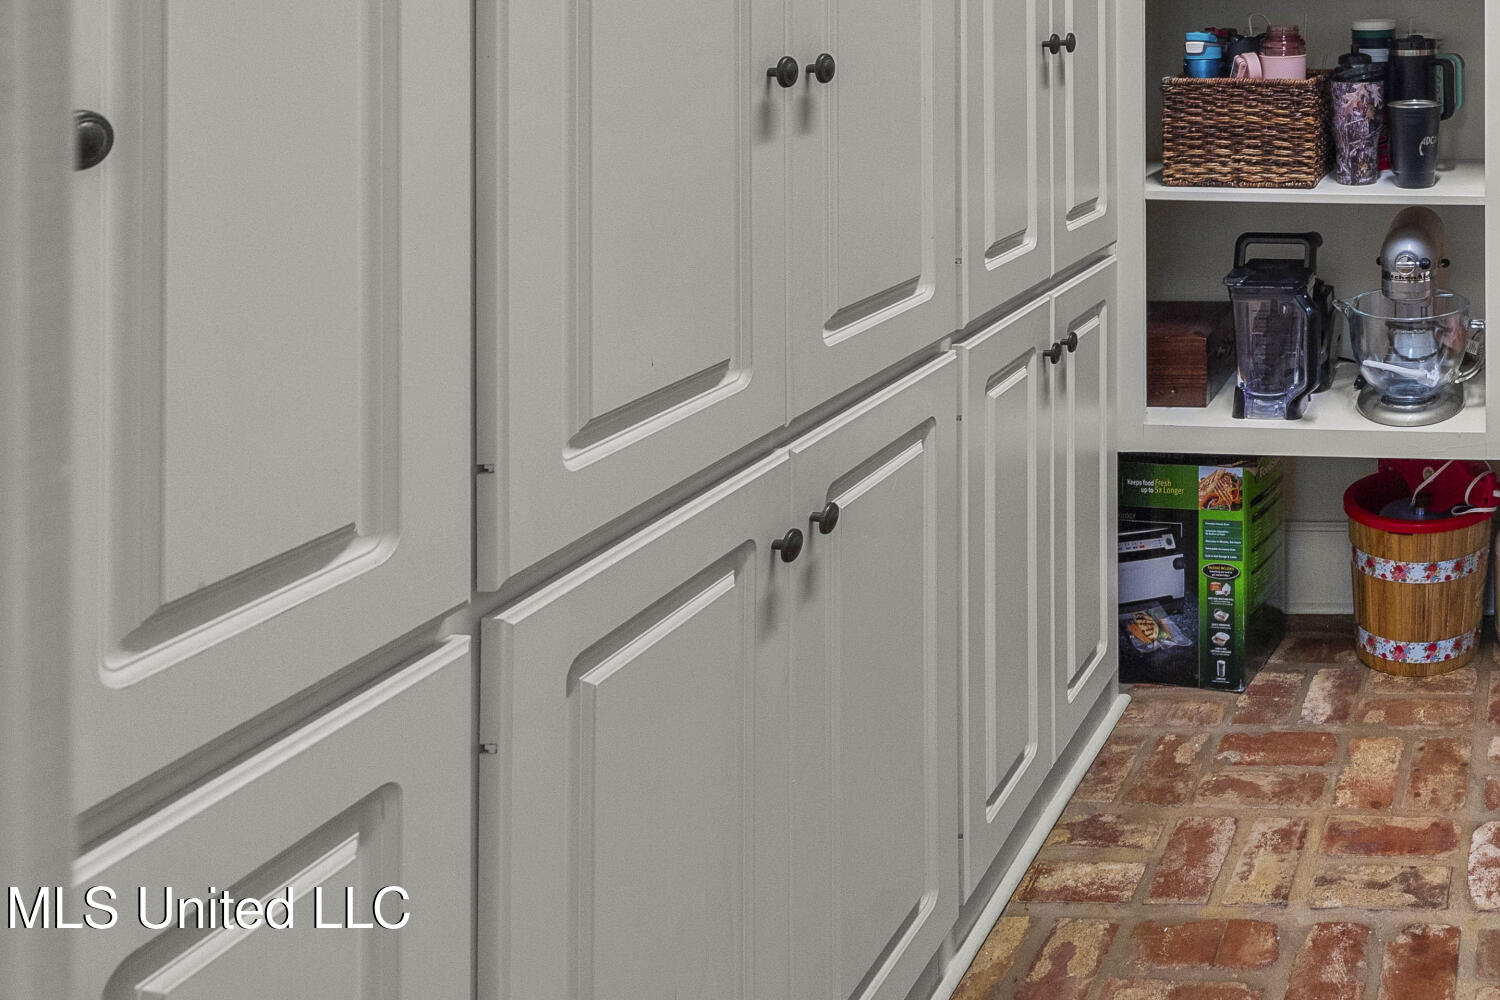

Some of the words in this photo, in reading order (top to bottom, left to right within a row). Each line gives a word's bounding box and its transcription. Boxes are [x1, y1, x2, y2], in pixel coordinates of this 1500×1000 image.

[1127, 479, 1143, 487] Keeps
[1143, 479, 1154, 487] food
[1155, 479, 1172, 487] Fresh
[1163, 487, 1184, 496] Longer
